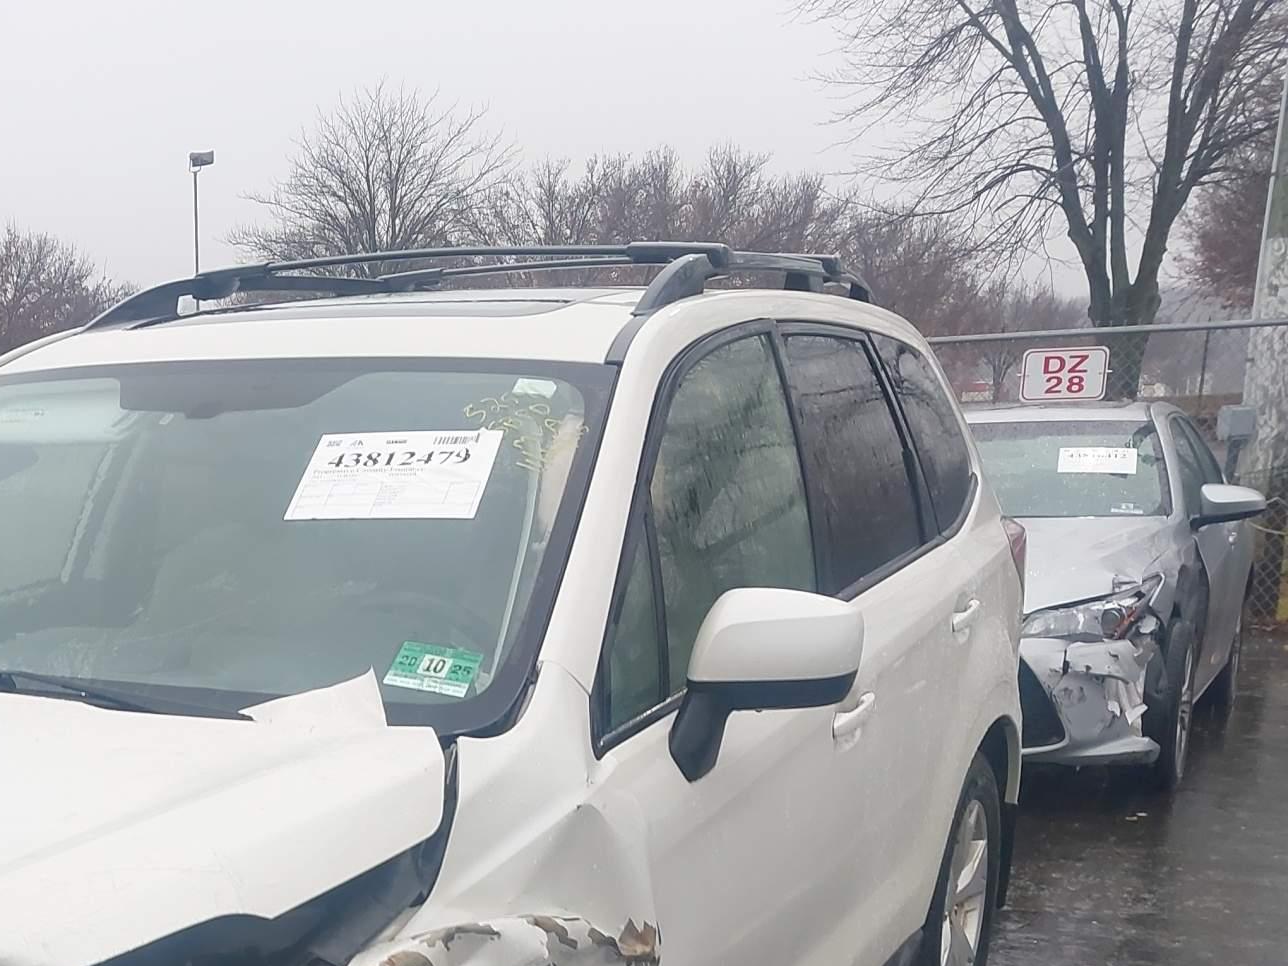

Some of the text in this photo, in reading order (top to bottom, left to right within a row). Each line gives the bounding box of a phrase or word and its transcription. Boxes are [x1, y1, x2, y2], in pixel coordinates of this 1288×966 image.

[1043, 355, 1089, 374] DZ
[1044, 376, 1084, 394] 28
[327, 448, 472, 468] 43812479
[399, 655, 473, 677] 20 10 25
